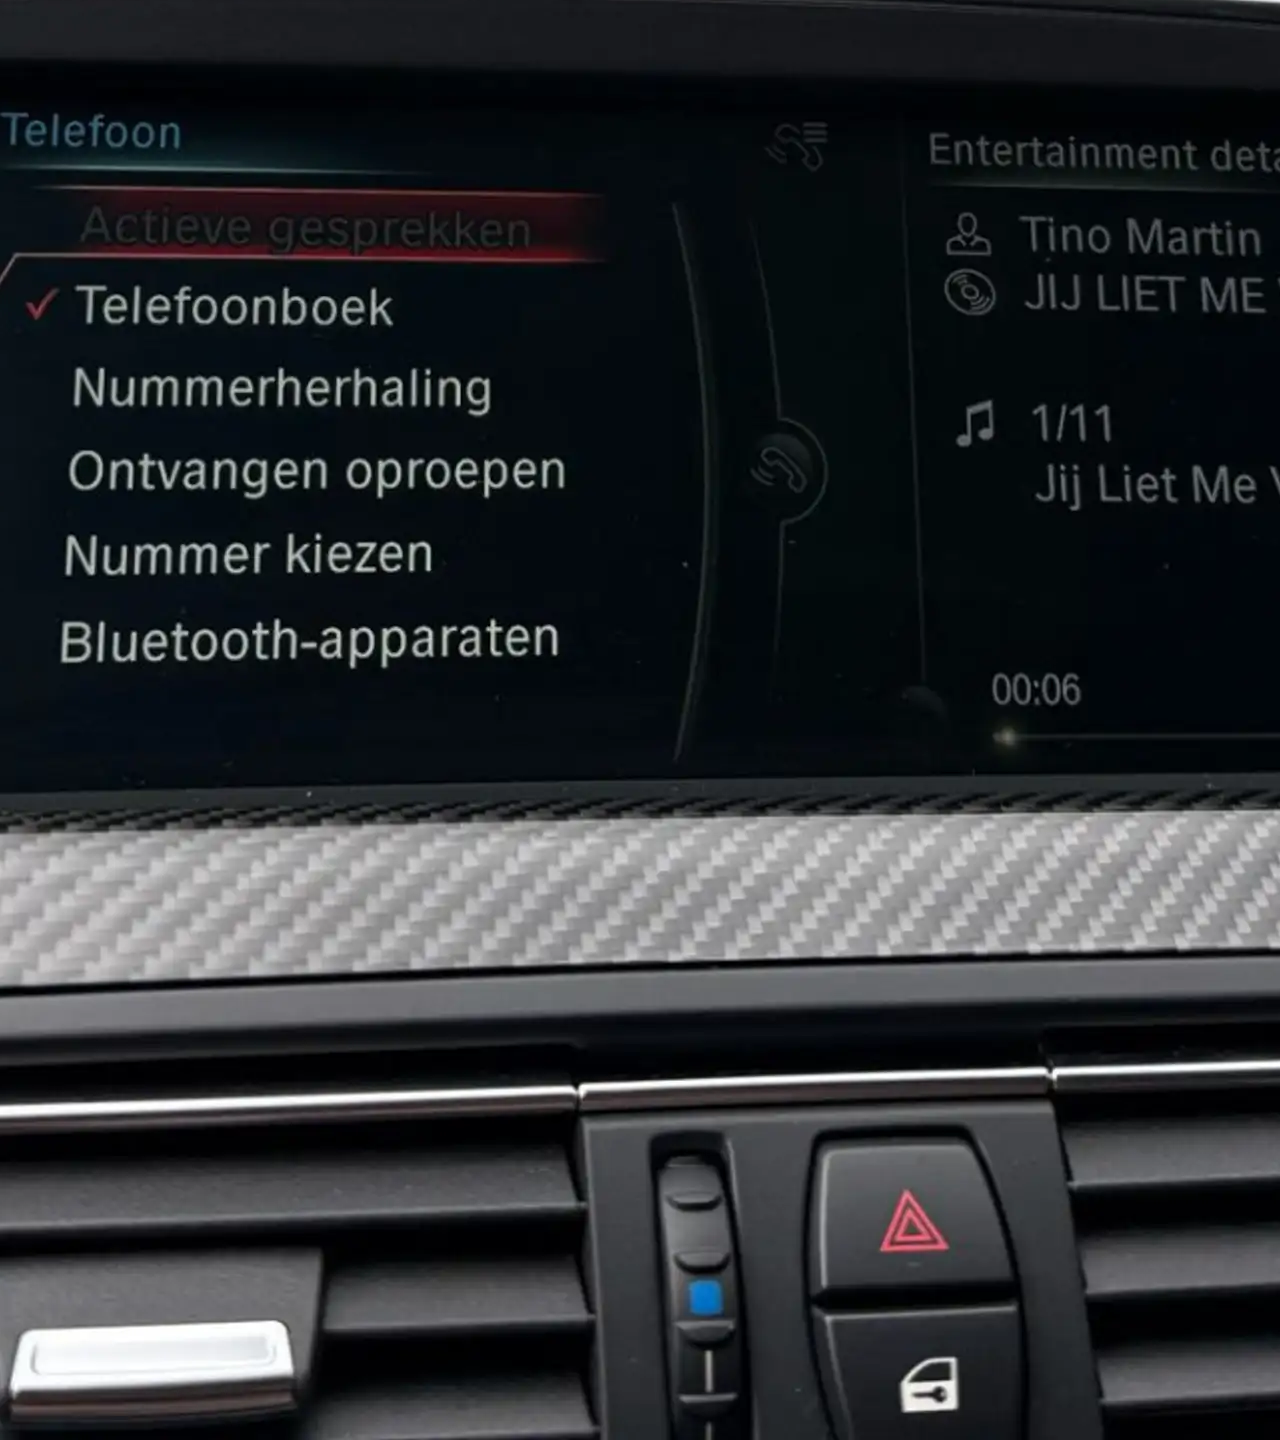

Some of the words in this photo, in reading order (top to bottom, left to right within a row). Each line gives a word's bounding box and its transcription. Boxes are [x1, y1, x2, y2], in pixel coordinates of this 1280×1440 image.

[0, 111, 181, 150] Telefoon
[929, 132, 1199, 172] Entertainment
[81, 206, 252, 248] Actieve
[269, 212, 531, 254] gesprekken
[1019, 215, 1112, 255] Tino
[1126, 217, 1262, 256] Martin
[75, 285, 393, 326] Telefoonboek
[1024, 273, 1081, 311] JIJ
[1097, 274, 1186, 313] LIET
[1200, 276, 1267, 314] ME
[73, 366, 491, 417] Nummerherhaling
[1032, 403, 1112, 442] 1/11
[68, 449, 328, 500] Ontvangen
[345, 457, 565, 499] oproepen
[1035, 463, 1082, 512] Jij
[1098, 464, 1178, 504] Liet
[1191, 464, 1257, 504] Me
[65, 534, 271, 576] Nummer
[286, 532, 432, 574] kiezen
[60, 618, 559, 669] Bluetooth-apparaten
[991, 672, 1082, 706] 00:06
